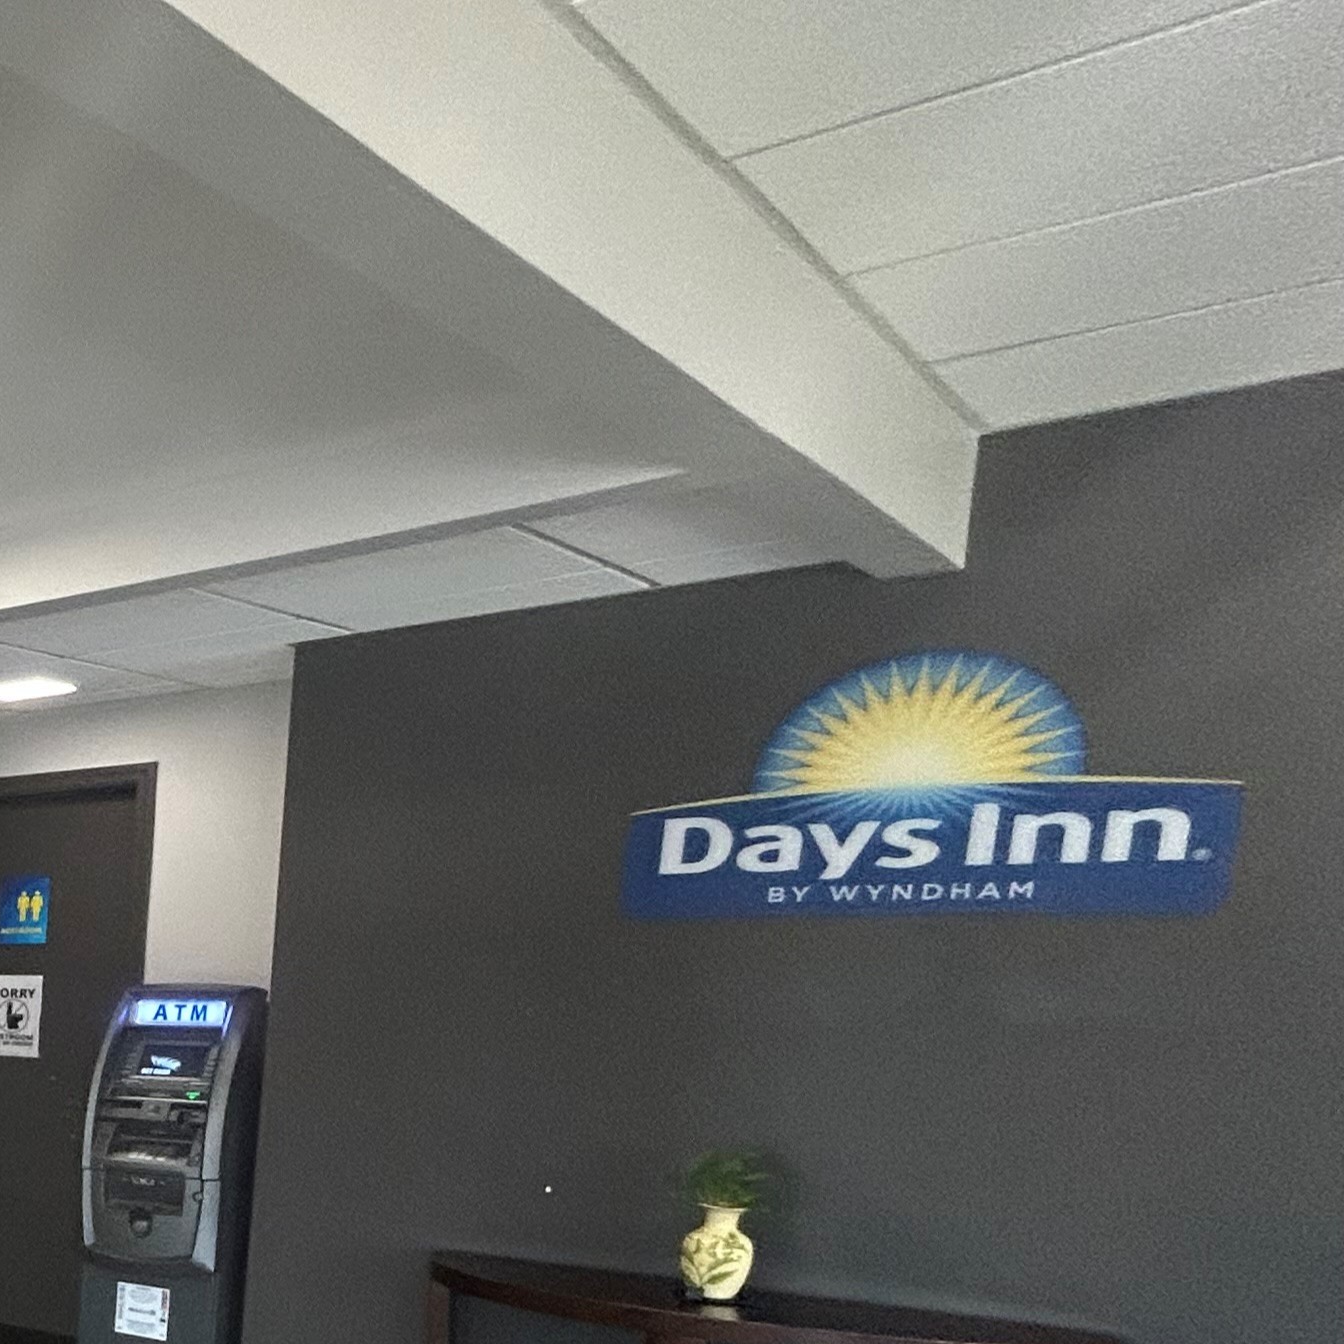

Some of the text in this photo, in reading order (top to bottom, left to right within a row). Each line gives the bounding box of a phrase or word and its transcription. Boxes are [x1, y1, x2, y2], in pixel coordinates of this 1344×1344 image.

[658, 803, 1194, 880] Days Inn
[767, 881, 1036, 904] BY WYNDHAM
[153, 1004, 208, 1022] ATM
